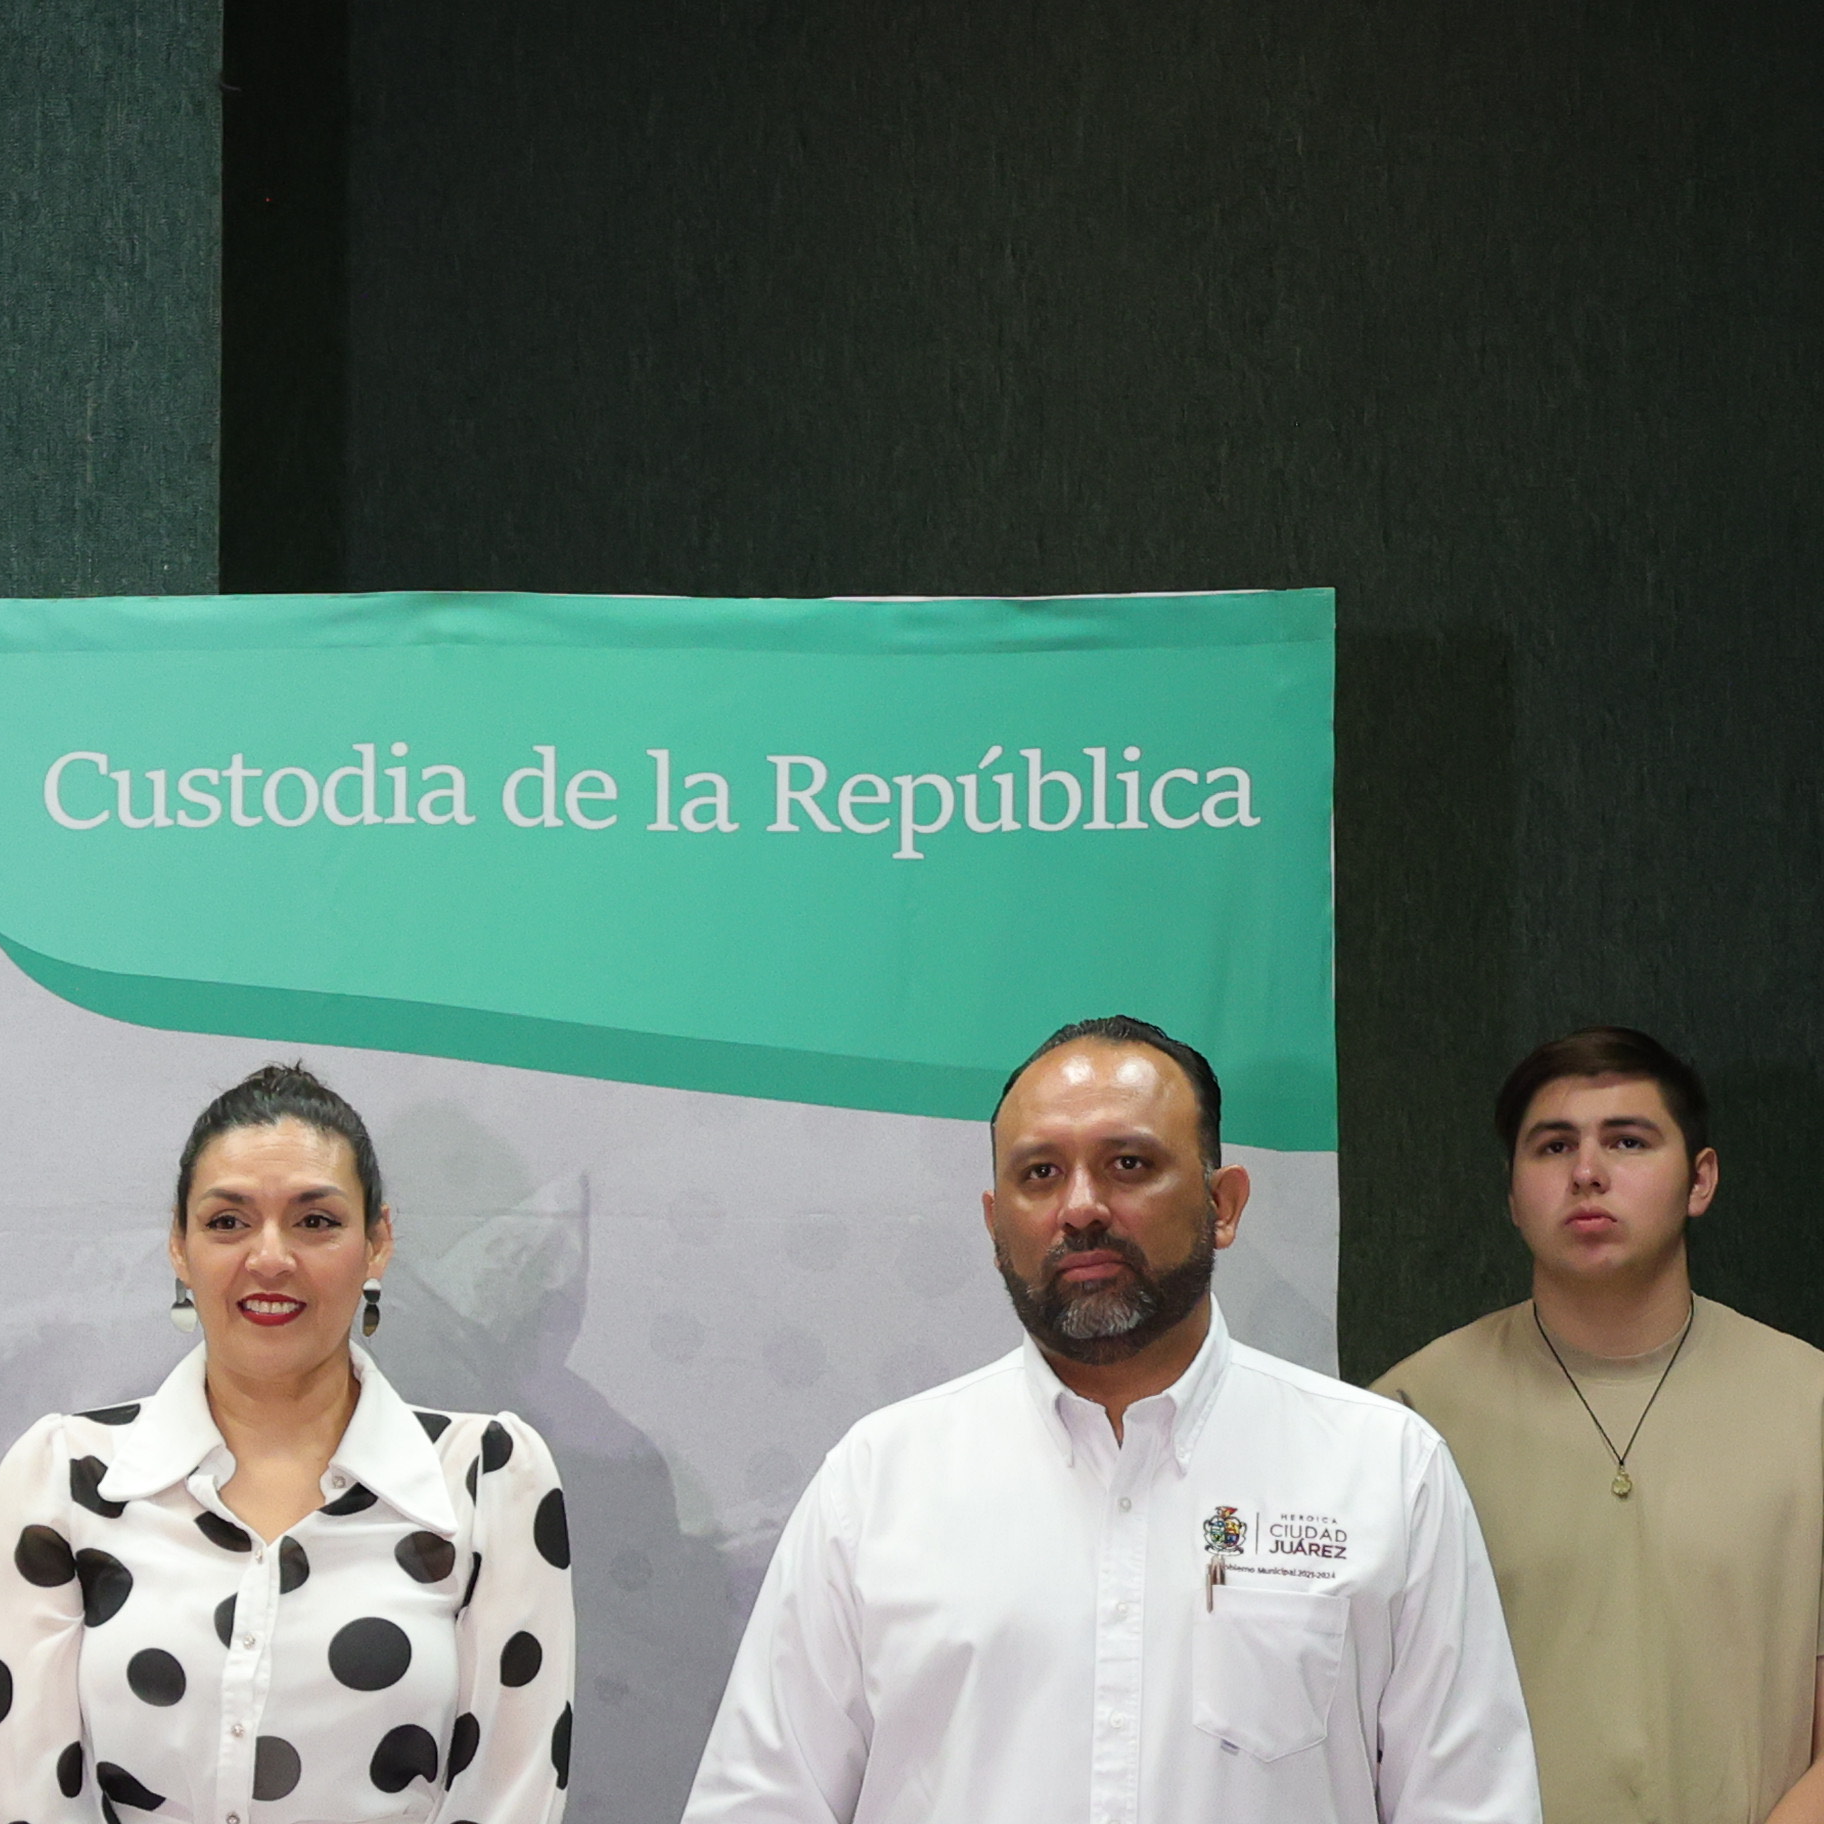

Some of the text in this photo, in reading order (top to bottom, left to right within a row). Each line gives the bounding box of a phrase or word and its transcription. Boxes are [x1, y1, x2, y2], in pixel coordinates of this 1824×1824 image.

[43, 741, 1261, 860] Custodia de la República
[1269, 1523, 1348, 1543] CIUDAD
[1268, 1538, 1348, 1560] JUÁREZ
[1225, 1563, 1255, 1574] obierno
